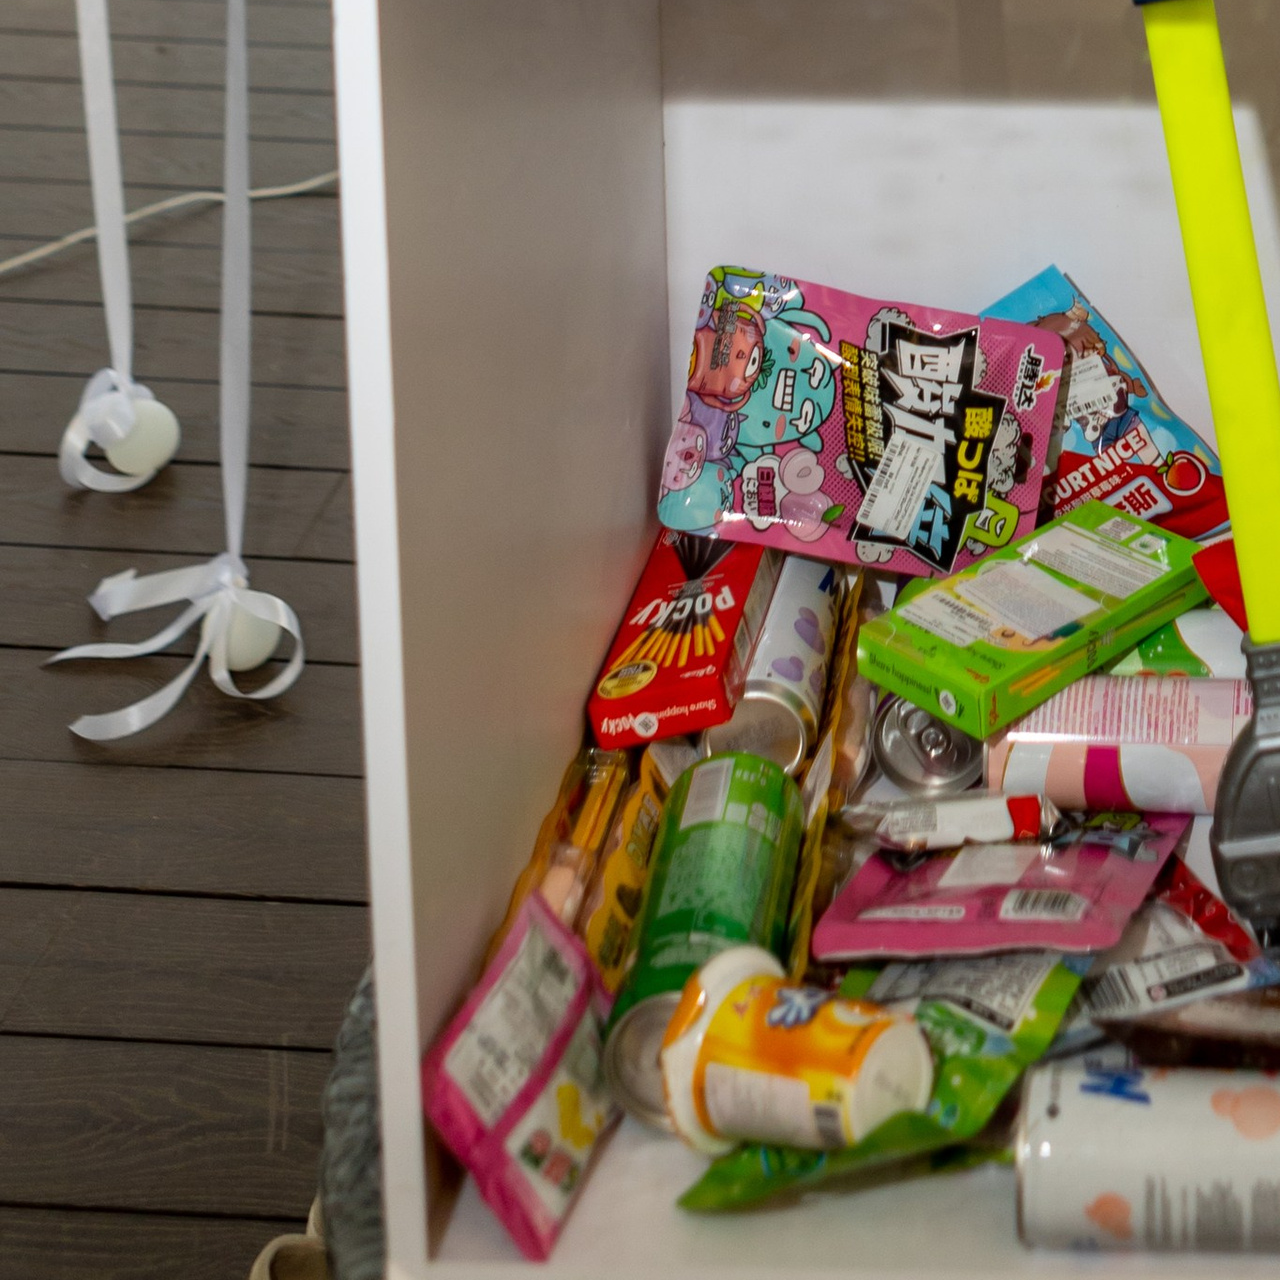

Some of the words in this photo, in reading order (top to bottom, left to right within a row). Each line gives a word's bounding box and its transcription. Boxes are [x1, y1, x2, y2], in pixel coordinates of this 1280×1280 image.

[1096, 428, 1147, 475] NICE
[628, 585, 736, 629] Pocky
[688, 698, 717, 716] Share
